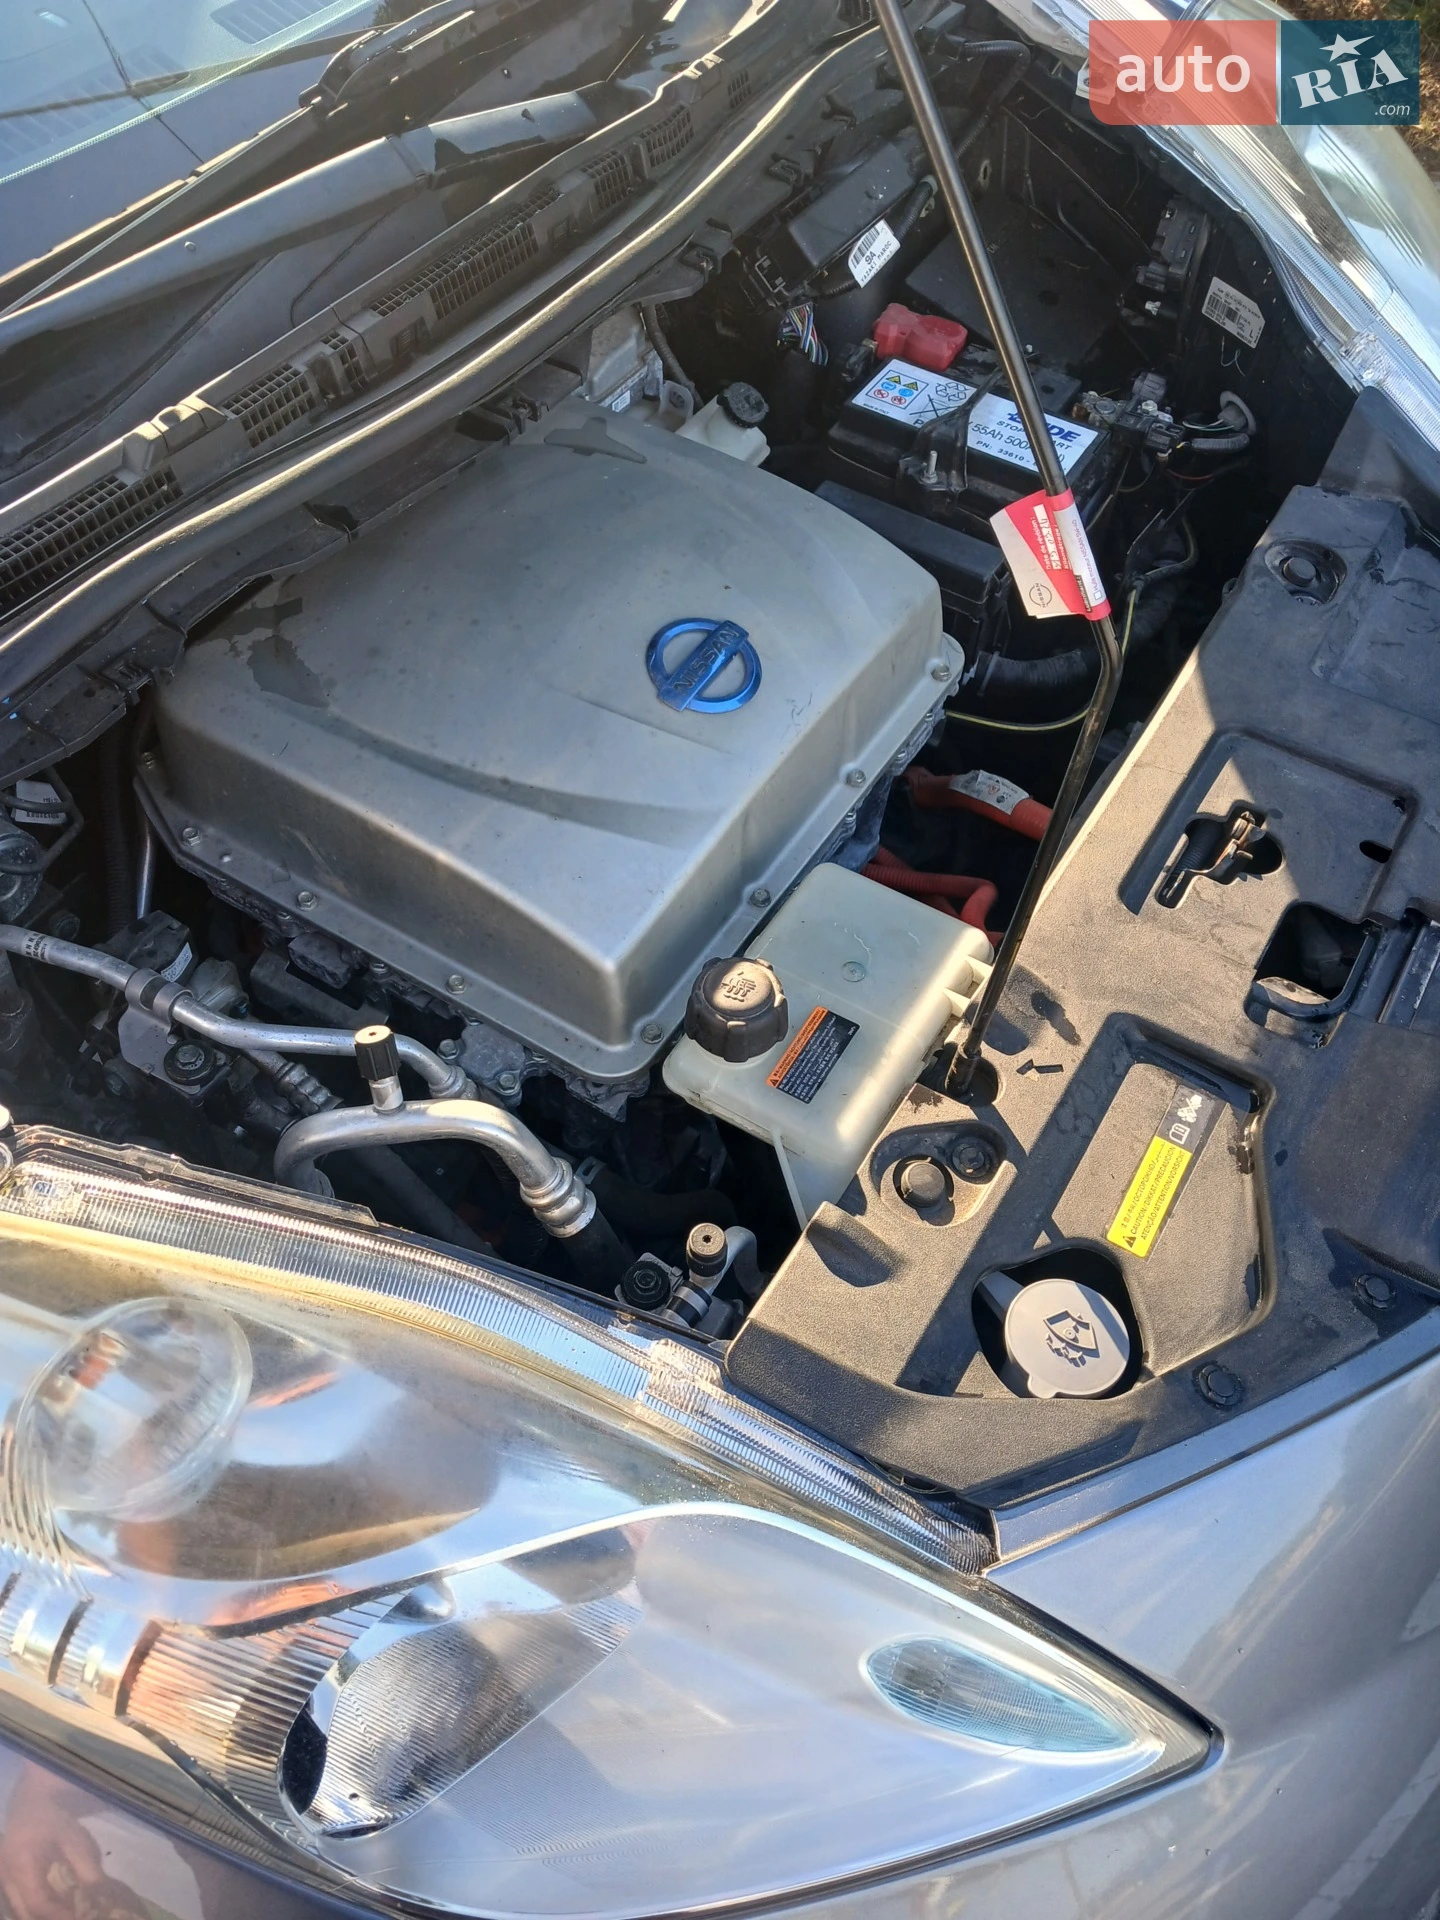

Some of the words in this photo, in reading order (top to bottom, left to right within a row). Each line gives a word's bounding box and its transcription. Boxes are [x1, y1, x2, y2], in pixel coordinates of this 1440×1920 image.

[861, 261, 877, 282] YAZAKI
[877, 240, 892, 259] MAROC
[864, 250, 877, 265] 9A
[971, 423, 1003, 441] 55Ah
[998, 448, 1024, 461] 33610
[1040, 545, 1046, 553] de
[1077, 538, 1087, 557] NISSAN
[1035, 583, 1046, 608] NISSAN
[672, 629, 739, 695] NISSAN
